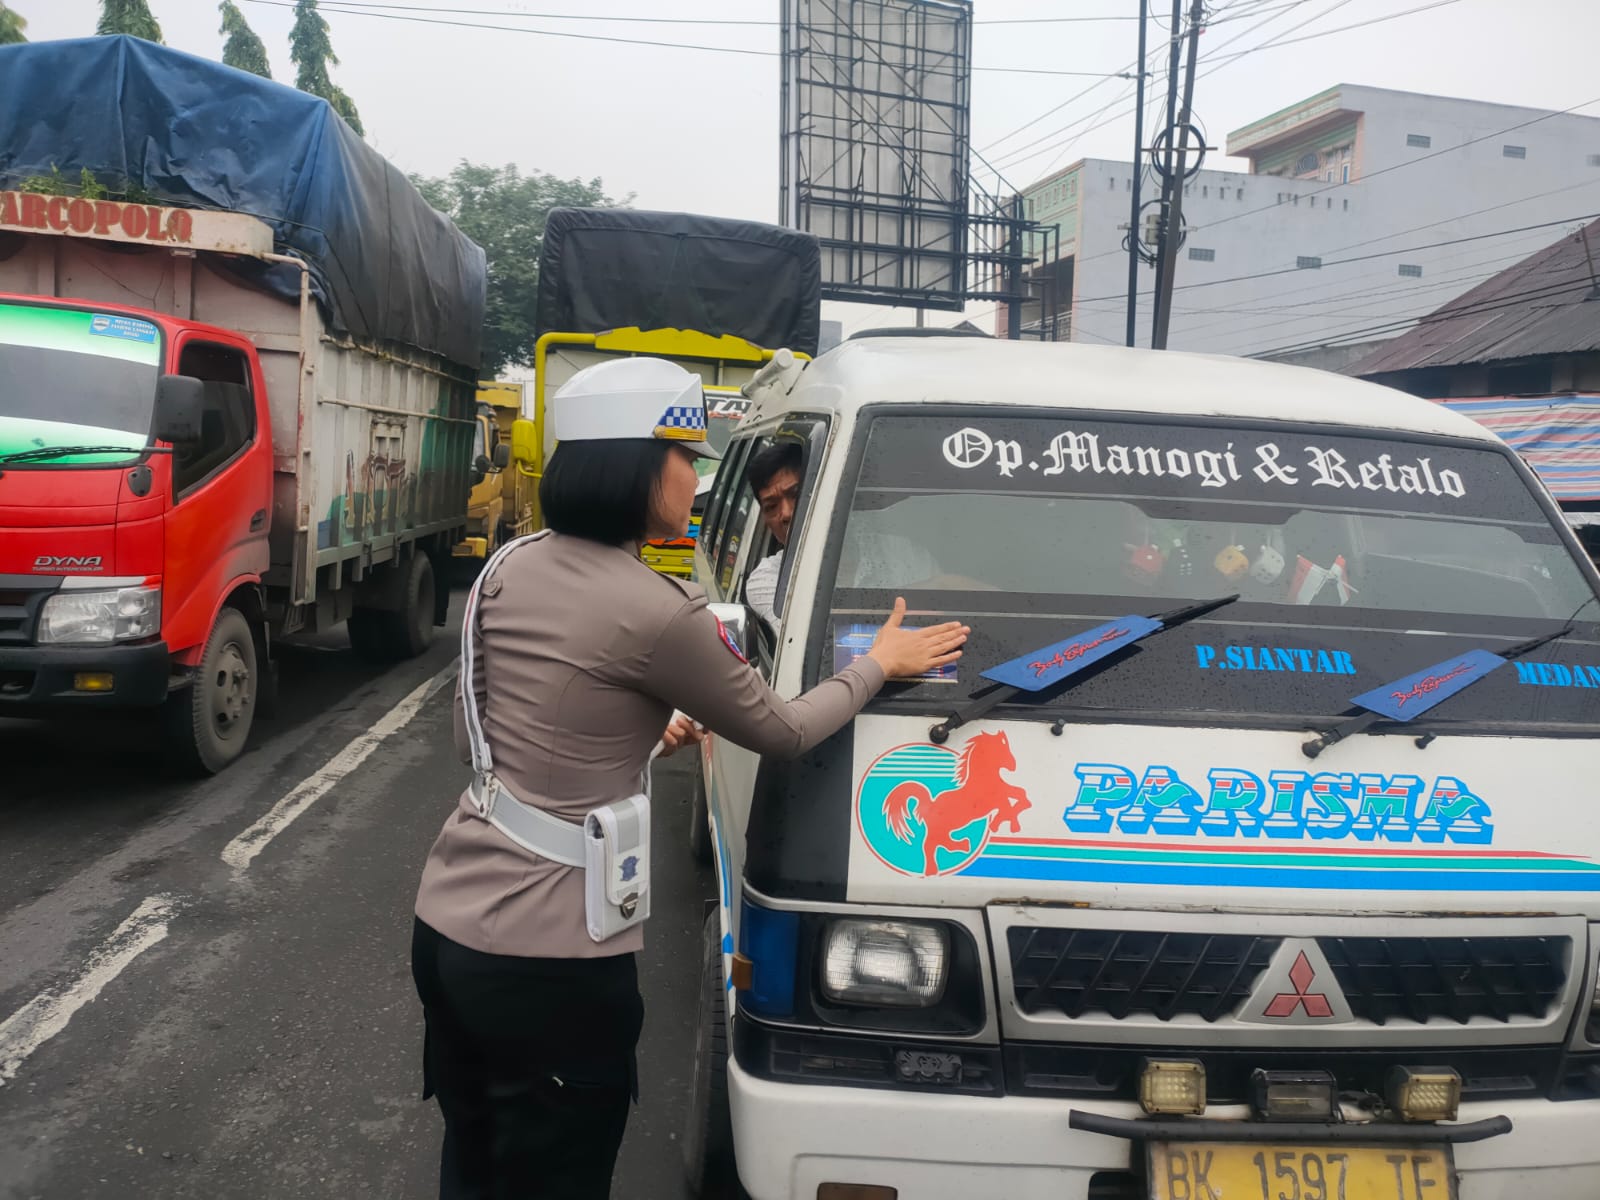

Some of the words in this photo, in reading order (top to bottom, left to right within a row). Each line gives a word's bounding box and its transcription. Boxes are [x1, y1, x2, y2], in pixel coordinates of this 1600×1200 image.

[942, 427, 1038, 478] Op.
[1043, 430, 1241, 488] Manogi
[1252, 442, 1299, 485] &
[1304, 446, 1466, 498] Refalo
[34, 555, 103, 566] DYNA
[1196, 645, 1356, 675] P.SIANTAR
[1512, 661, 1600, 688] MEDAN
[1062, 762, 1495, 845] PARISMA
[1167, 1150, 1217, 1200] BK
[1253, 1151, 1349, 1200] 1597
